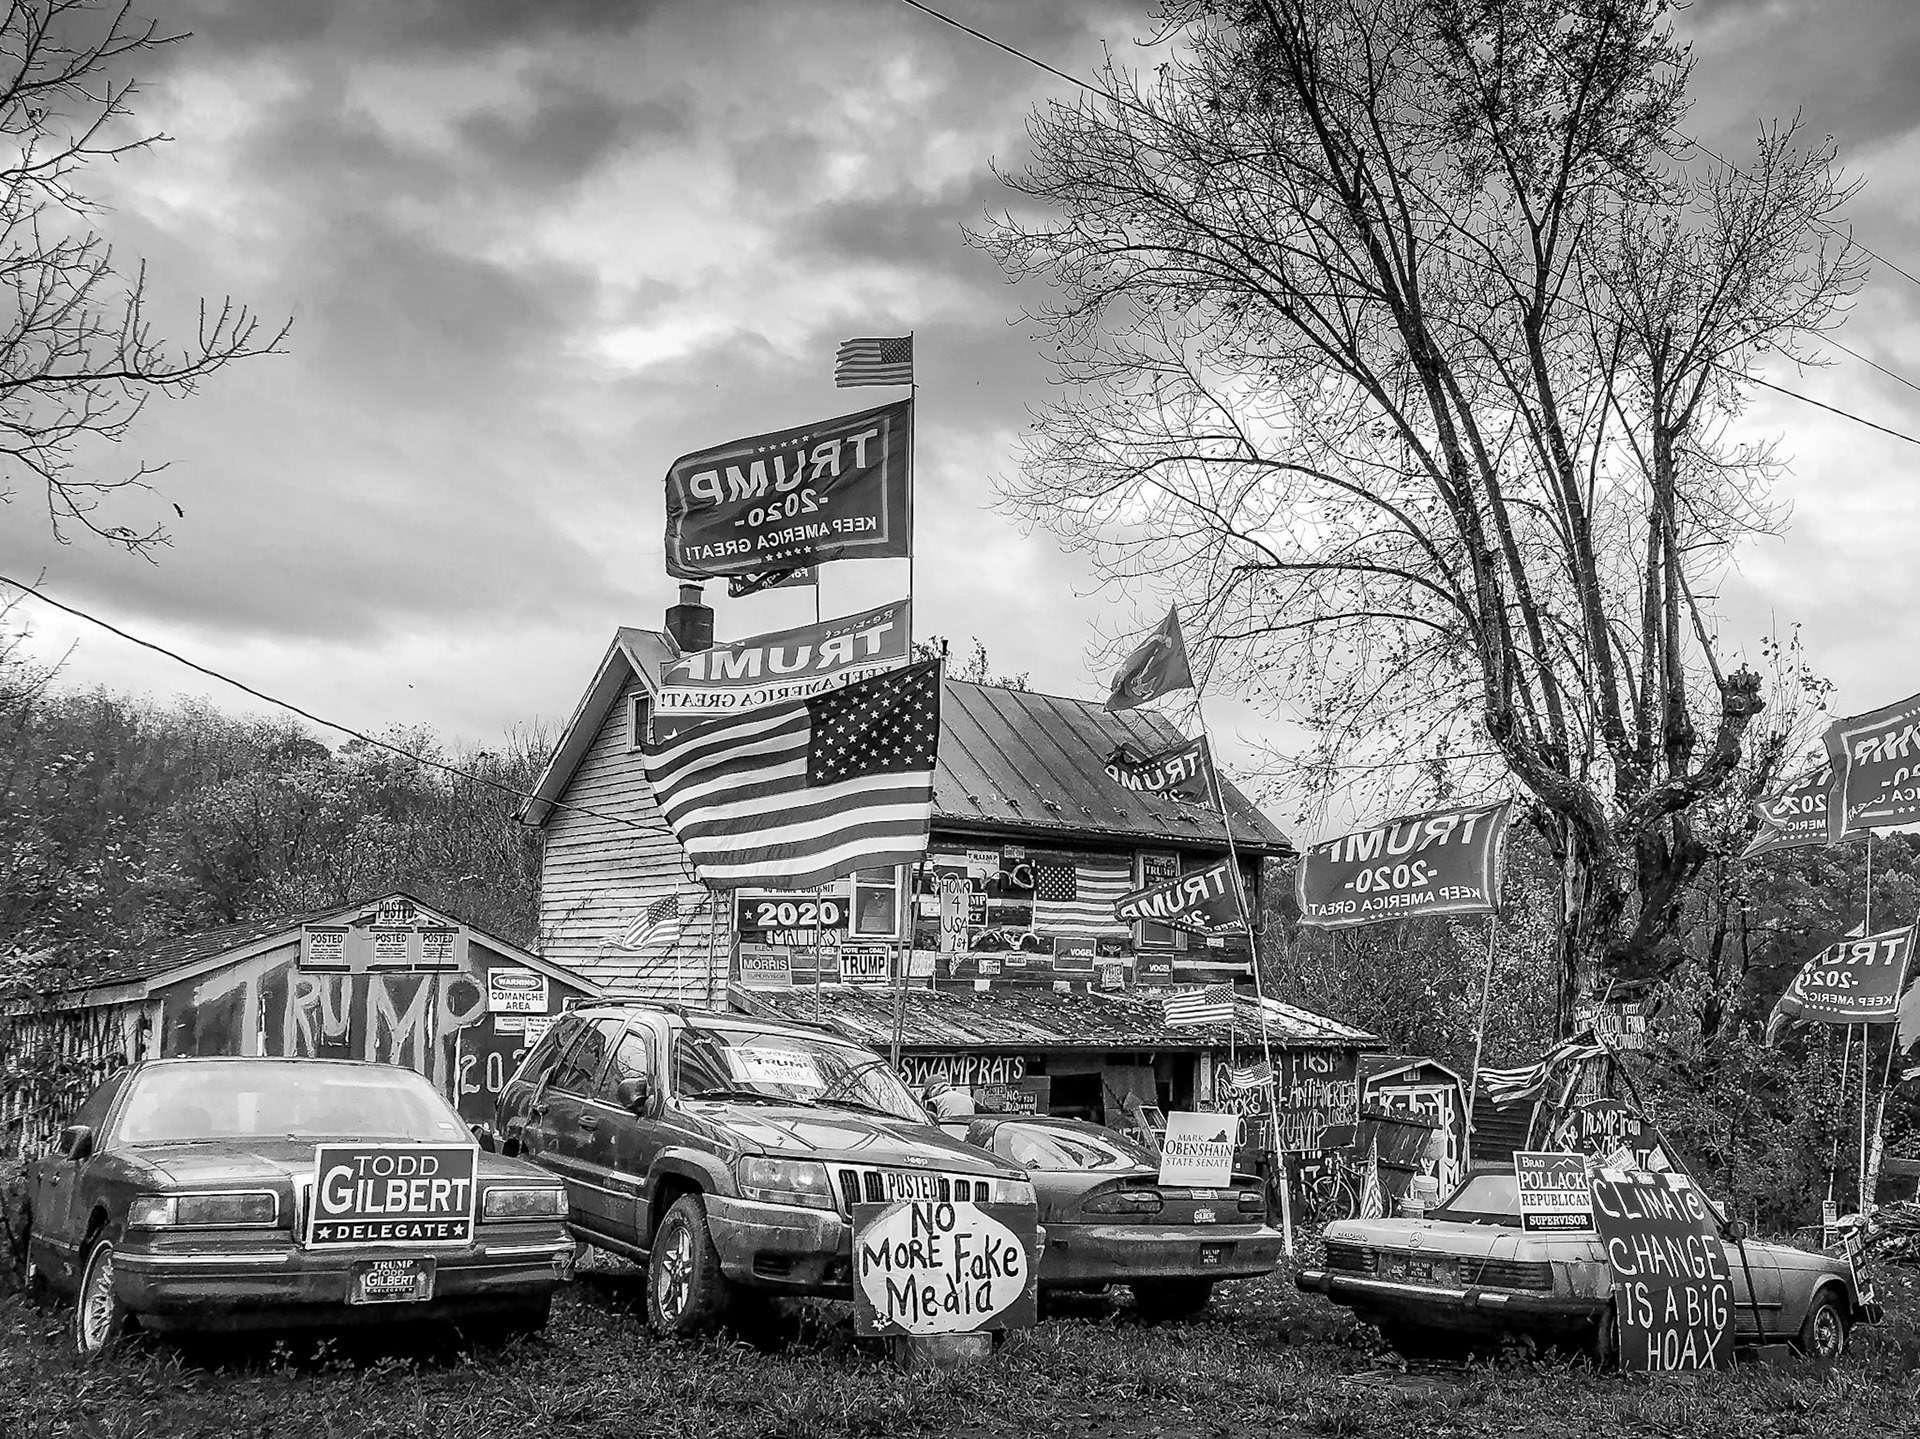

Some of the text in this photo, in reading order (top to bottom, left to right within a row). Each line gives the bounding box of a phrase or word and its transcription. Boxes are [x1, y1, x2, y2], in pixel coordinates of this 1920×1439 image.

[968, 853, 998, 861] TRUMP
[1145, 865, 1176, 877] TRUMP
[951, 896, 961, 914] 4
[757, 901, 840, 925] 2020
[942, 916, 968, 934] USA
[310, 934, 344, 944] POSTED
[375, 933, 407, 943] POSTED
[422, 933, 454, 943] POSTED
[1070, 948, 1094, 957] VOGEL
[743, 959, 787, 970] MORRIS
[841, 955, 885, 974] TRUMP
[1149, 964, 1172, 973] VOGEL
[498, 978, 537, 987] WARNING
[491, 991, 545, 1001] COMANCHE
[505, 1001, 531, 1010] AREA
[194, 972, 488, 1100] TRUMP
[1177, 1134, 1204, 1143] MARK
[1165, 1140, 1234, 1157] OBENSHAIN
[353, 1155, 439, 1176] TODD
[902, 1155, 929, 1166] Jeep
[1165, 1158, 1230, 1168] STATE SENATE
[1522, 1157, 1545, 1168] BRAD
[1519, 1171, 1586, 1190] POLLACK
[321, 1165, 470, 1214] GILBERT
[1521, 1193, 1590, 1208] REPUBLICAN
[911, 1202, 956, 1239] NO
[1528, 1214, 1589, 1226] SUPERVISOR
[336, 1224, 449, 1239] DELEGATE
[372, 1259, 414, 1270] TRUMP
[862, 1233, 1019, 1285] MORE Fake
[376, 1269, 405, 1277] TODD
[366, 1272, 416, 1287] GILBERT
[886, 1272, 994, 1323] Media
[1624, 1281, 1654, 1329] IS
[1665, 1285, 1679, 1323] A
[1647, 1328, 1723, 1371] HOAX
